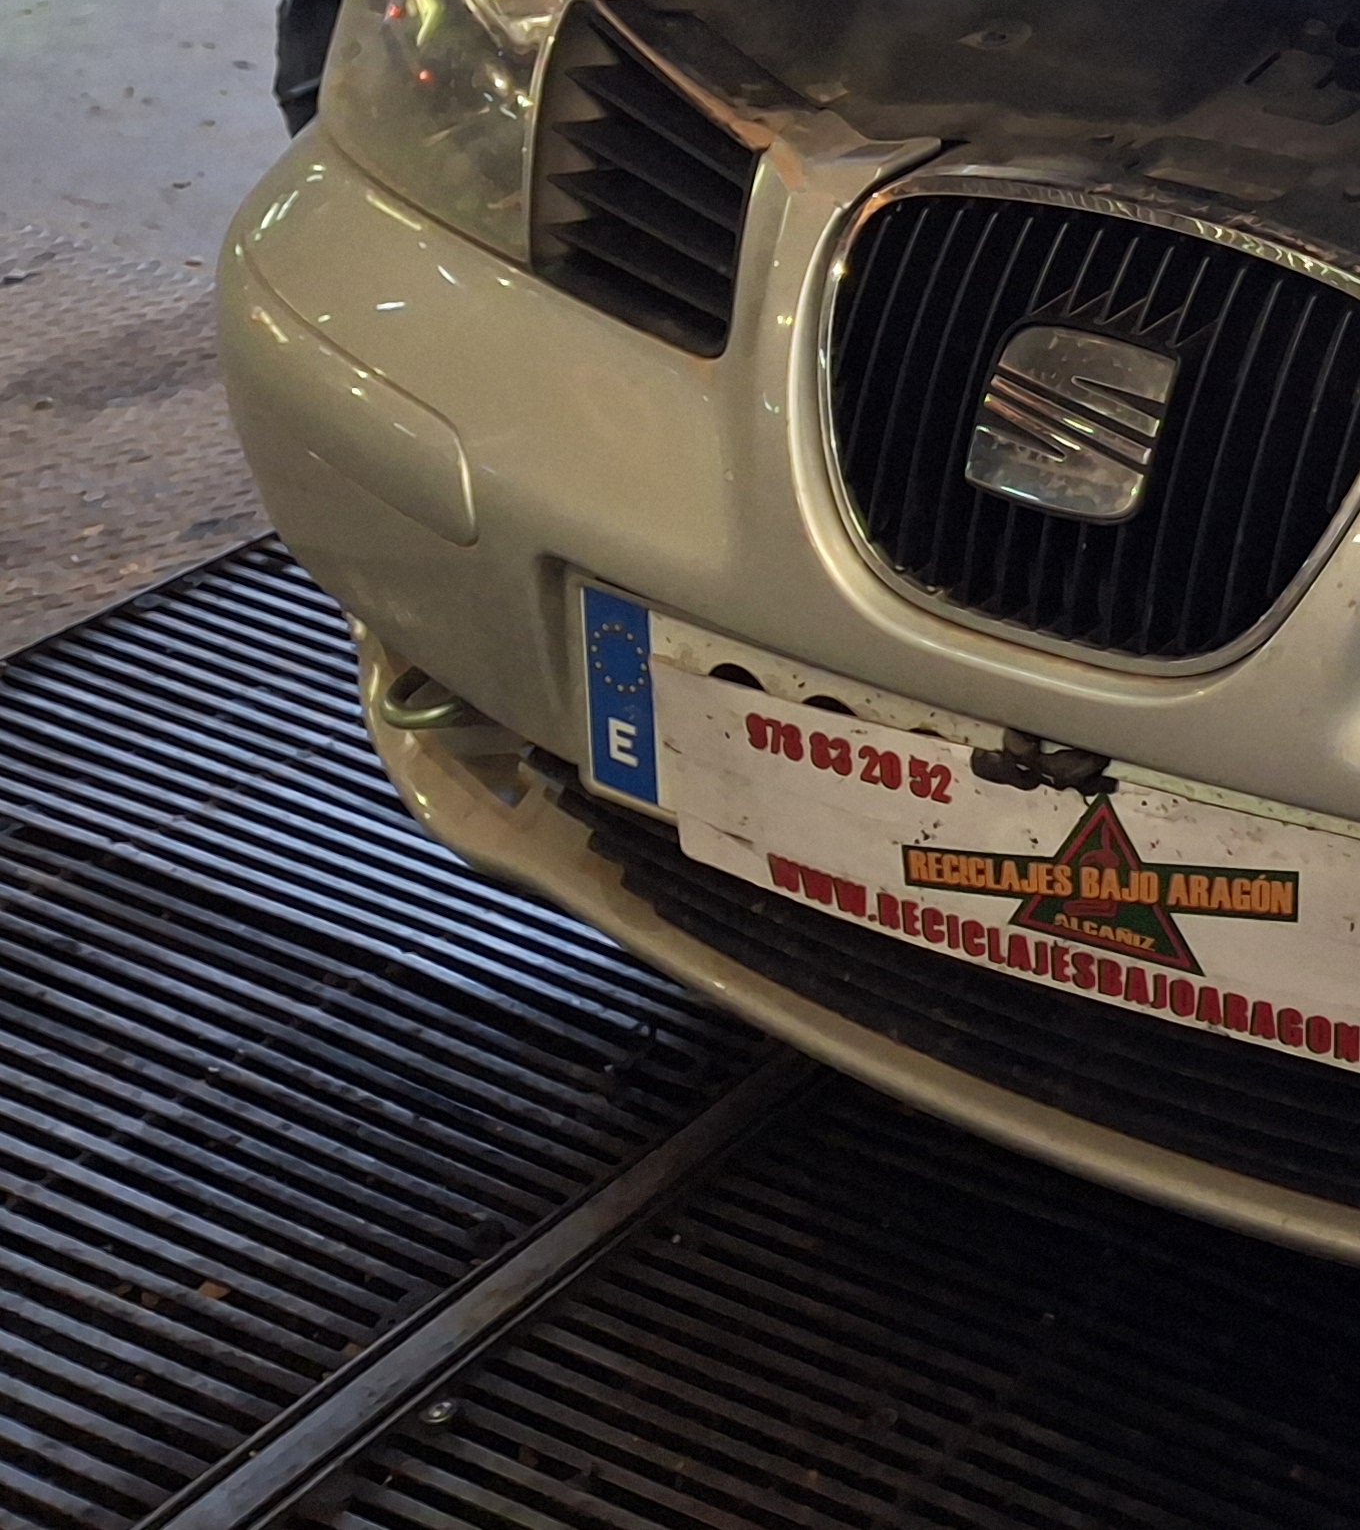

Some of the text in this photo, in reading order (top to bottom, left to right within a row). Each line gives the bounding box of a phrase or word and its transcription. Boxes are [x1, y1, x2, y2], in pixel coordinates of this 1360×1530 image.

[607, 716, 639, 767] E
[745, 712, 952, 804] 978 83 20 52
[907, 849, 1294, 915] RECICLAJES BAJO ARAGÓN
[1053, 913, 1158, 952] ALCAÑIZ
